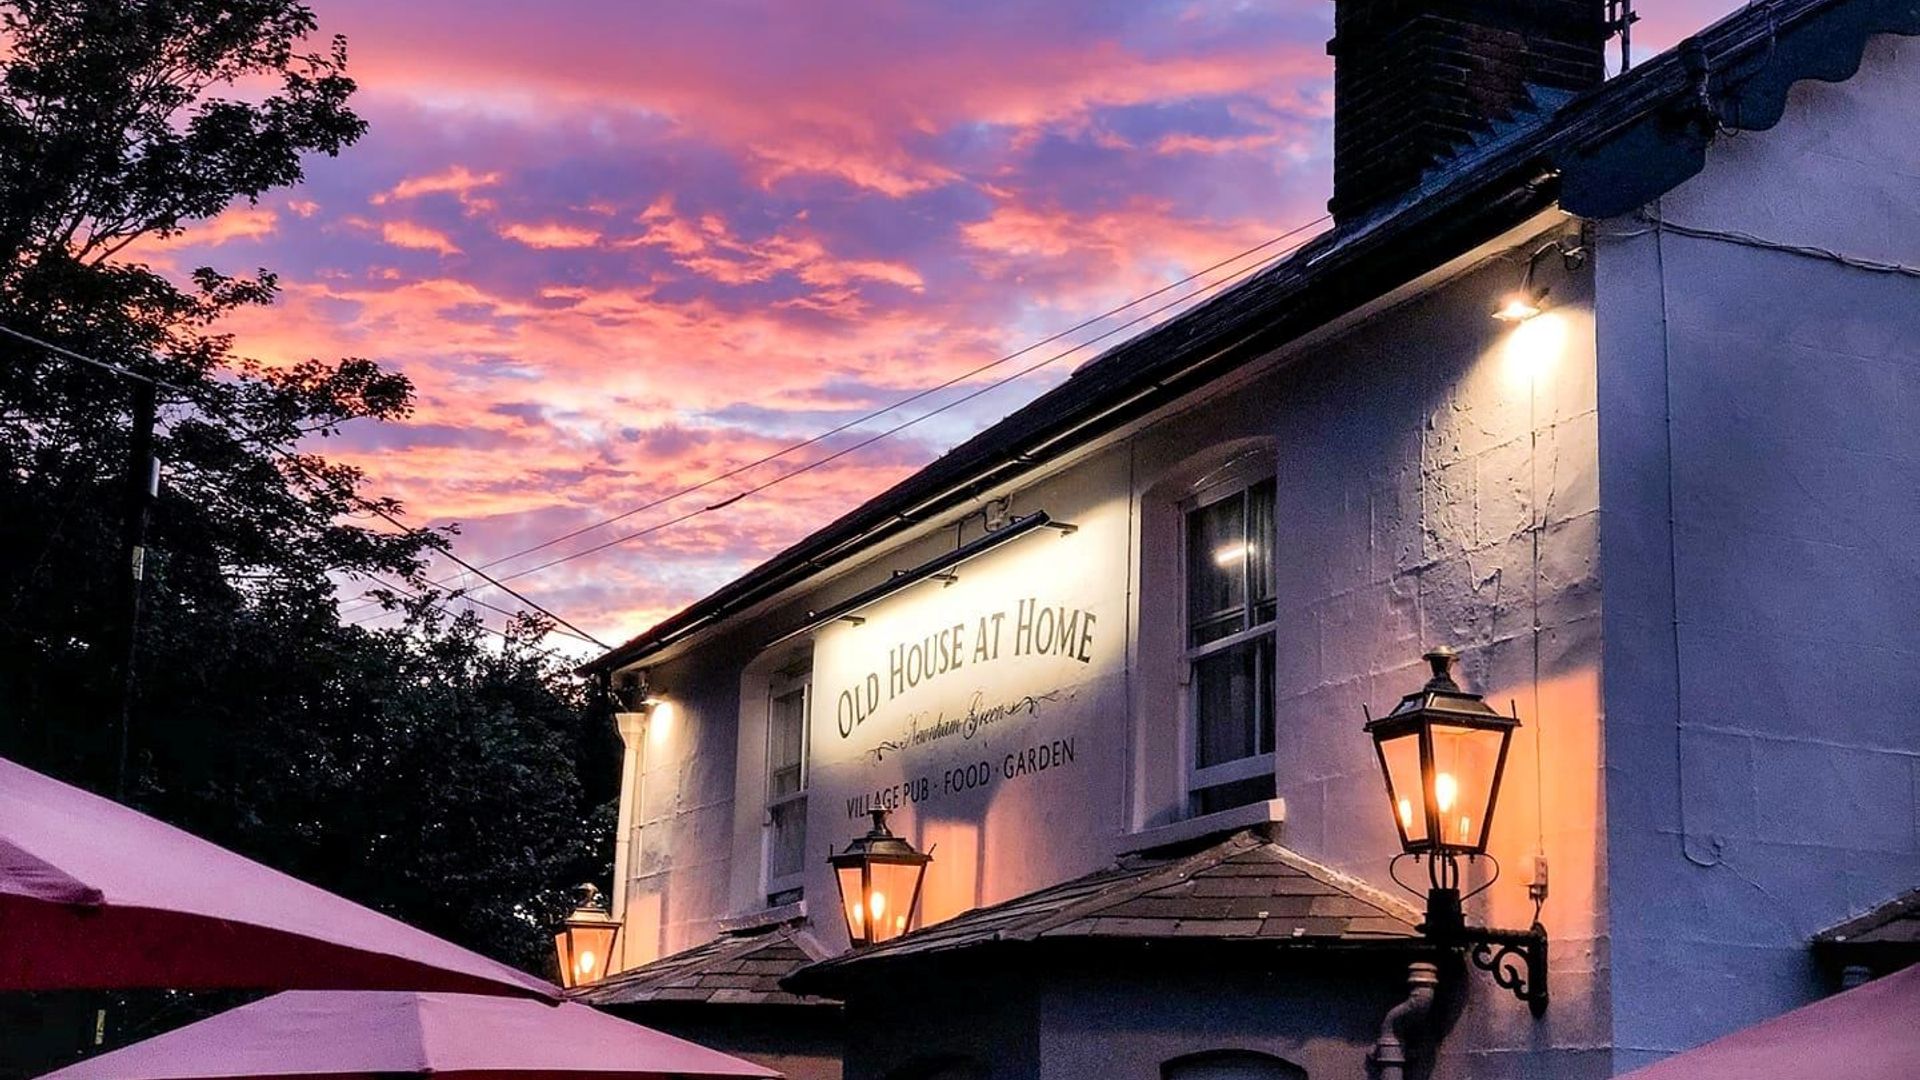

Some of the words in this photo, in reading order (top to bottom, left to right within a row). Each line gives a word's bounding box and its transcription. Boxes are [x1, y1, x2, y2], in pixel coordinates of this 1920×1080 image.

[838, 672, 879, 739] OLD
[889, 623, 965, 701] HOUSE
[972, 611, 1005, 664] AT
[1014, 598, 1096, 664] HOME
[962, 690, 1005, 740] Green
[846, 785, 899, 819] VILLAGE
[903, 777, 929, 807] PUB
[944, 761, 990, 795] FOOD
[1003, 737, 1075, 779] GARDEN
